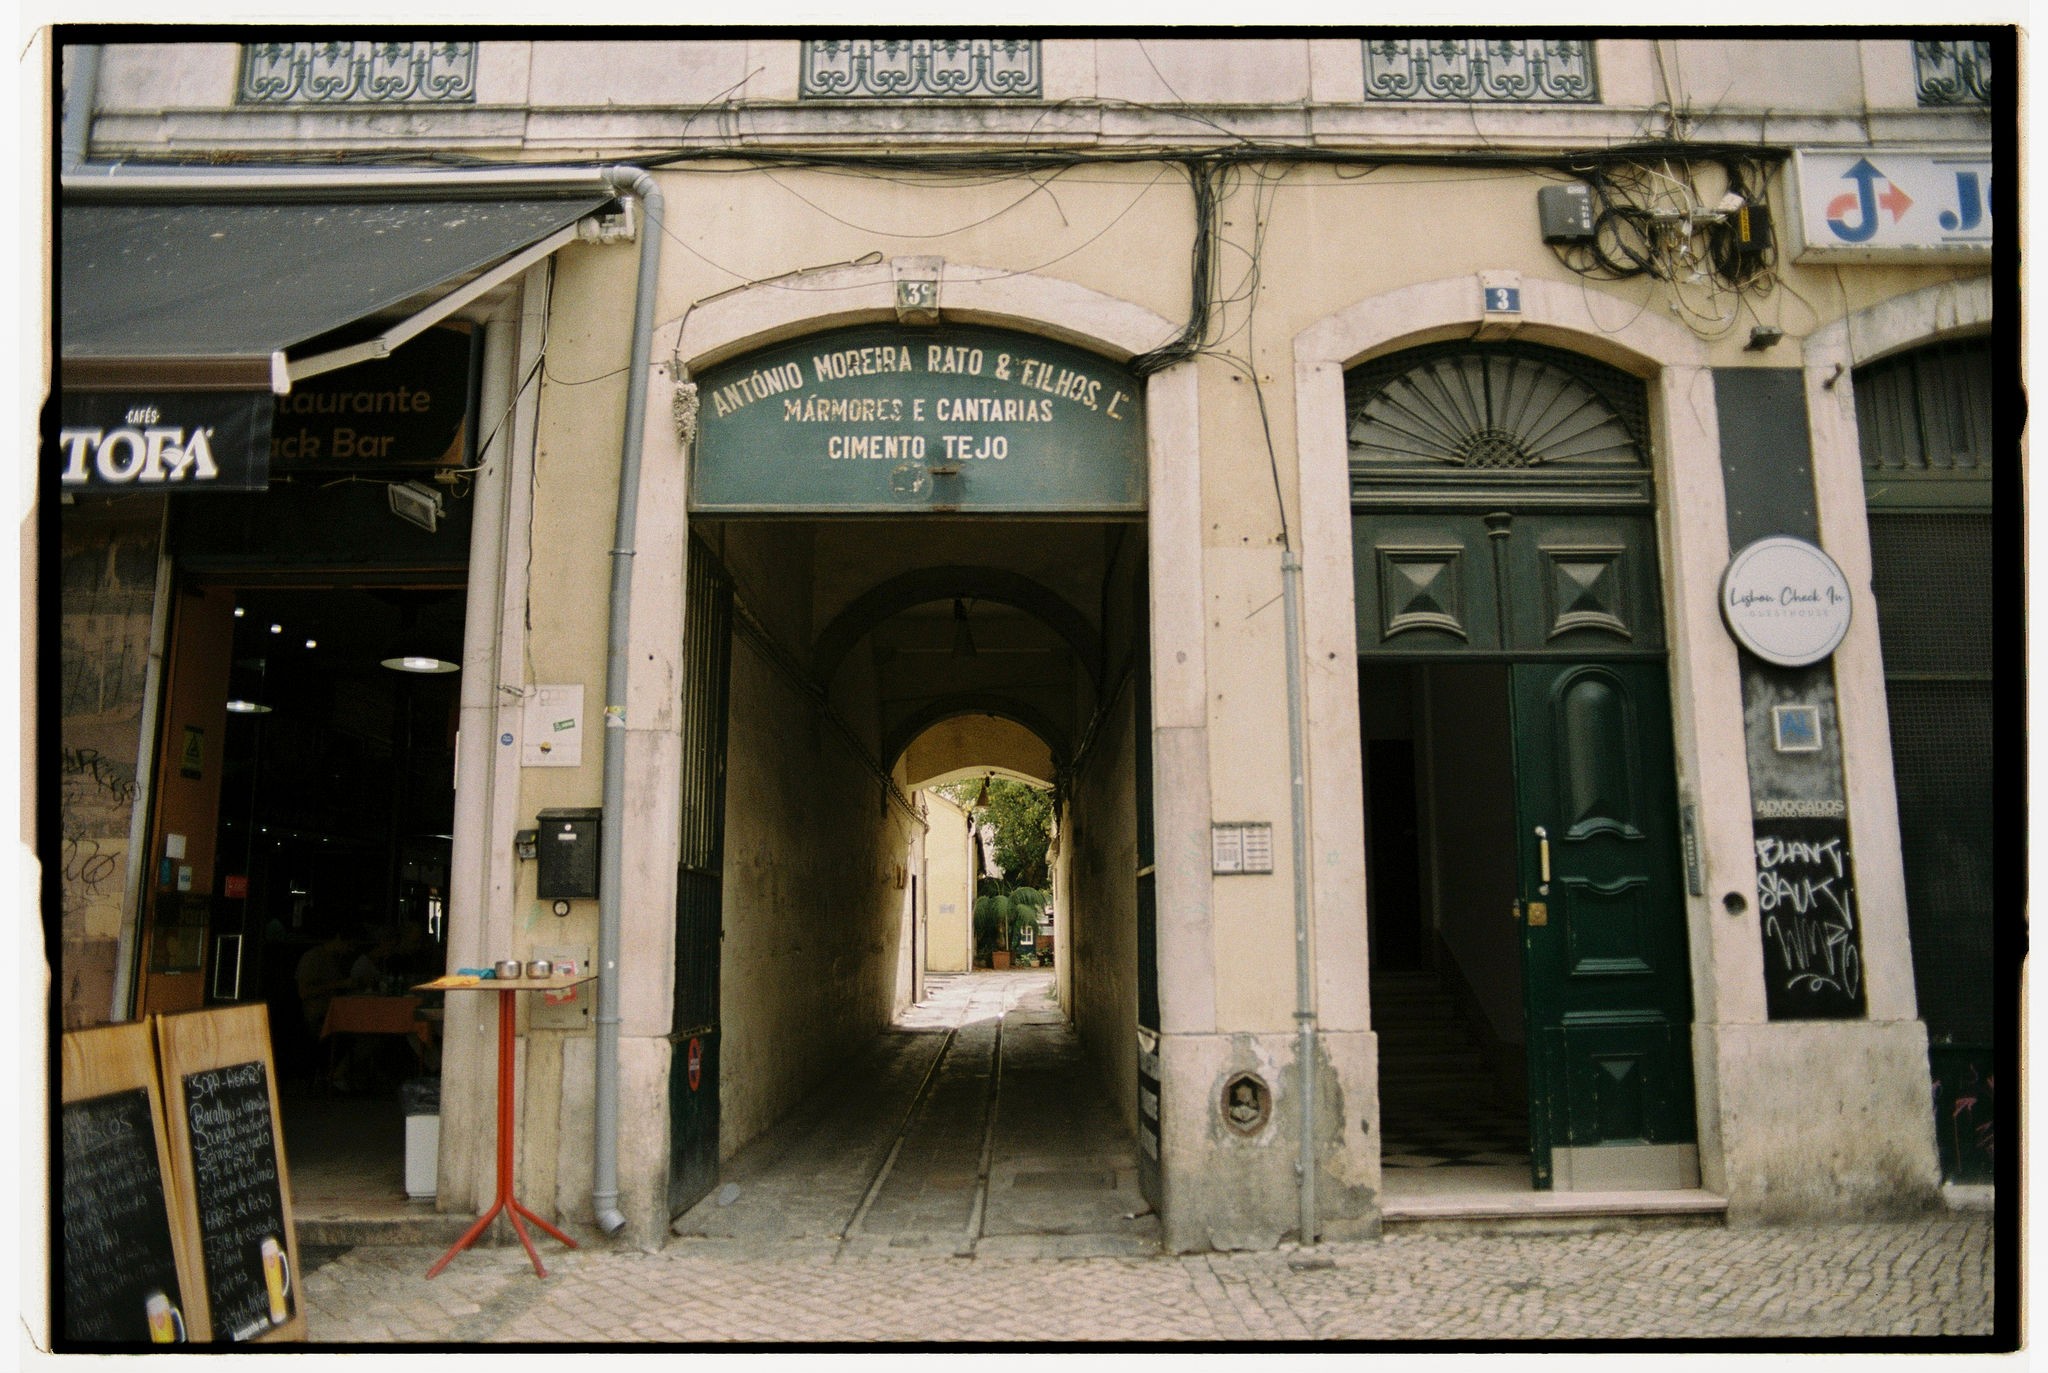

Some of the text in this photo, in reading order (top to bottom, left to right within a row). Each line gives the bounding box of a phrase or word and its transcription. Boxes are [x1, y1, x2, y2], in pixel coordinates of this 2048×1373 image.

[1939, 171, 1992, 231] J
[1497, 288, 1509, 310] 3
[712, 362, 803, 418] ANTÓNIO
[813, 345, 912, 382] MOREIRA
[928, 345, 983, 375] RATO
[995, 353, 1011, 381] &
[279, 385, 432, 411] taurante
[784, 394, 1053, 422] MÁRMORES E CANTARIAS
[60, 427, 219, 482] TOFA
[331, 427, 395, 458] Bar
[828, 436, 1008, 460] CIMENTO TEJO
[1730, 586, 1844, 607] Lisbon Check In
[1757, 799, 1844, 813] ADVOGADOS
